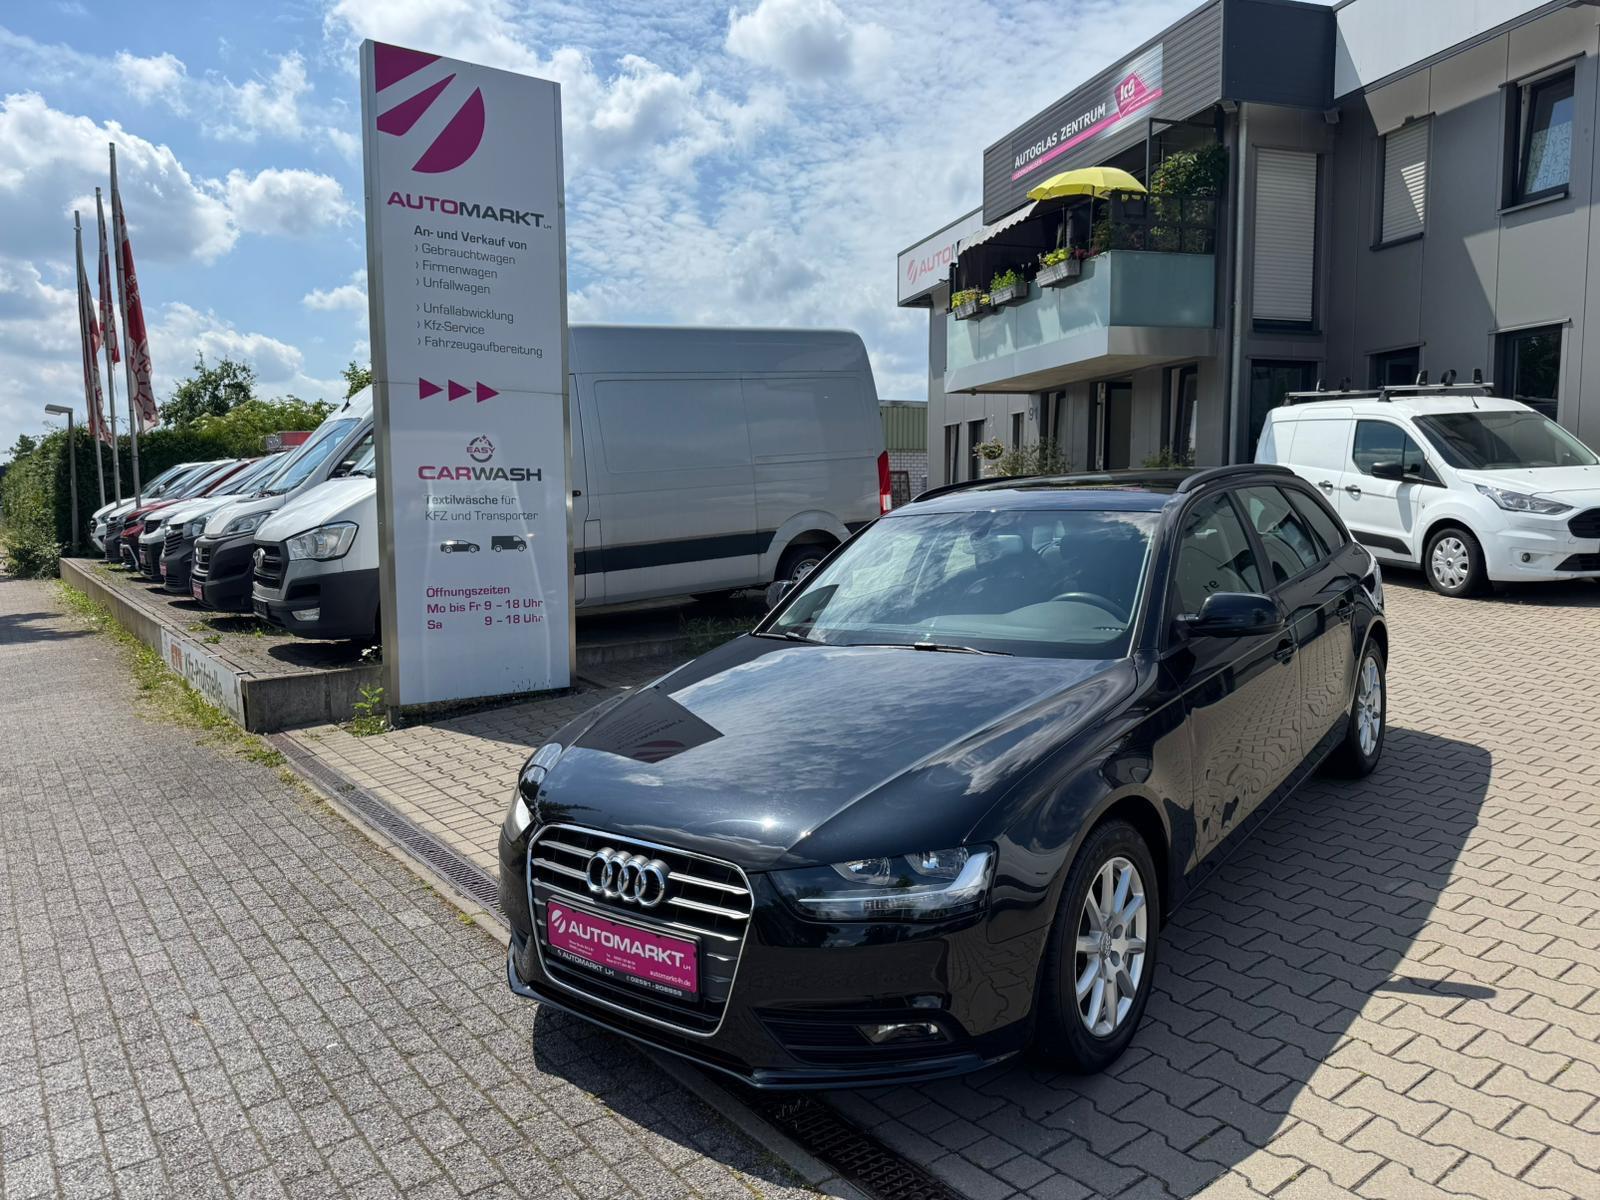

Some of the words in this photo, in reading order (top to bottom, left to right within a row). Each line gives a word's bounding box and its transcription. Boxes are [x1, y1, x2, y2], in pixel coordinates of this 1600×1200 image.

[1014, 132, 1058, 169] AUTOGLAS
[1060, 103, 1106, 141] ZENTRUM
[387, 191, 545, 228] AUTOMARKT
[414, 225, 434, 237] An-
[436, 229, 458, 241] und
[461, 231, 506, 248] Verkauf
[508, 240, 528, 250] von
[421, 243, 516, 265] Gebrauchtwagen
[422, 260, 498, 279] Firmenwagen
[423, 276, 491, 295] Unfallwagen
[423, 303, 514, 324] Unfallabwicklung
[424, 319, 485, 335] Kfz-Service
[424, 336, 543, 358] Fahrzeugaufbereitung
[466, 446, 496, 454] EASY
[418, 465, 542, 482] CARWASH
[424, 494, 498, 505] Textilwäsche
[500, 495, 517, 505] für
[425, 510, 448, 521] KFZ
[451, 511, 471, 521] und
[474, 511, 539, 523] Transporter
[426, 585, 511, 598] Öffnungszeiten
[427, 603, 446, 613] Mo
[449, 602, 466, 612] bis
[469, 601, 481, 611] Fr
[484, 600, 492, 611] 9
[505, 599, 520, 609] 18
[523, 598, 543, 608] Uhr
[427, 620, 443, 630] Sa
[484, 616, 493, 626] 9
[505, 614, 520, 624] 18
[523, 613, 543, 623] Uhr
[568, 920, 685, 968] AUTOMARKT
[562, 951, 604, 972] AUTOMARKT
